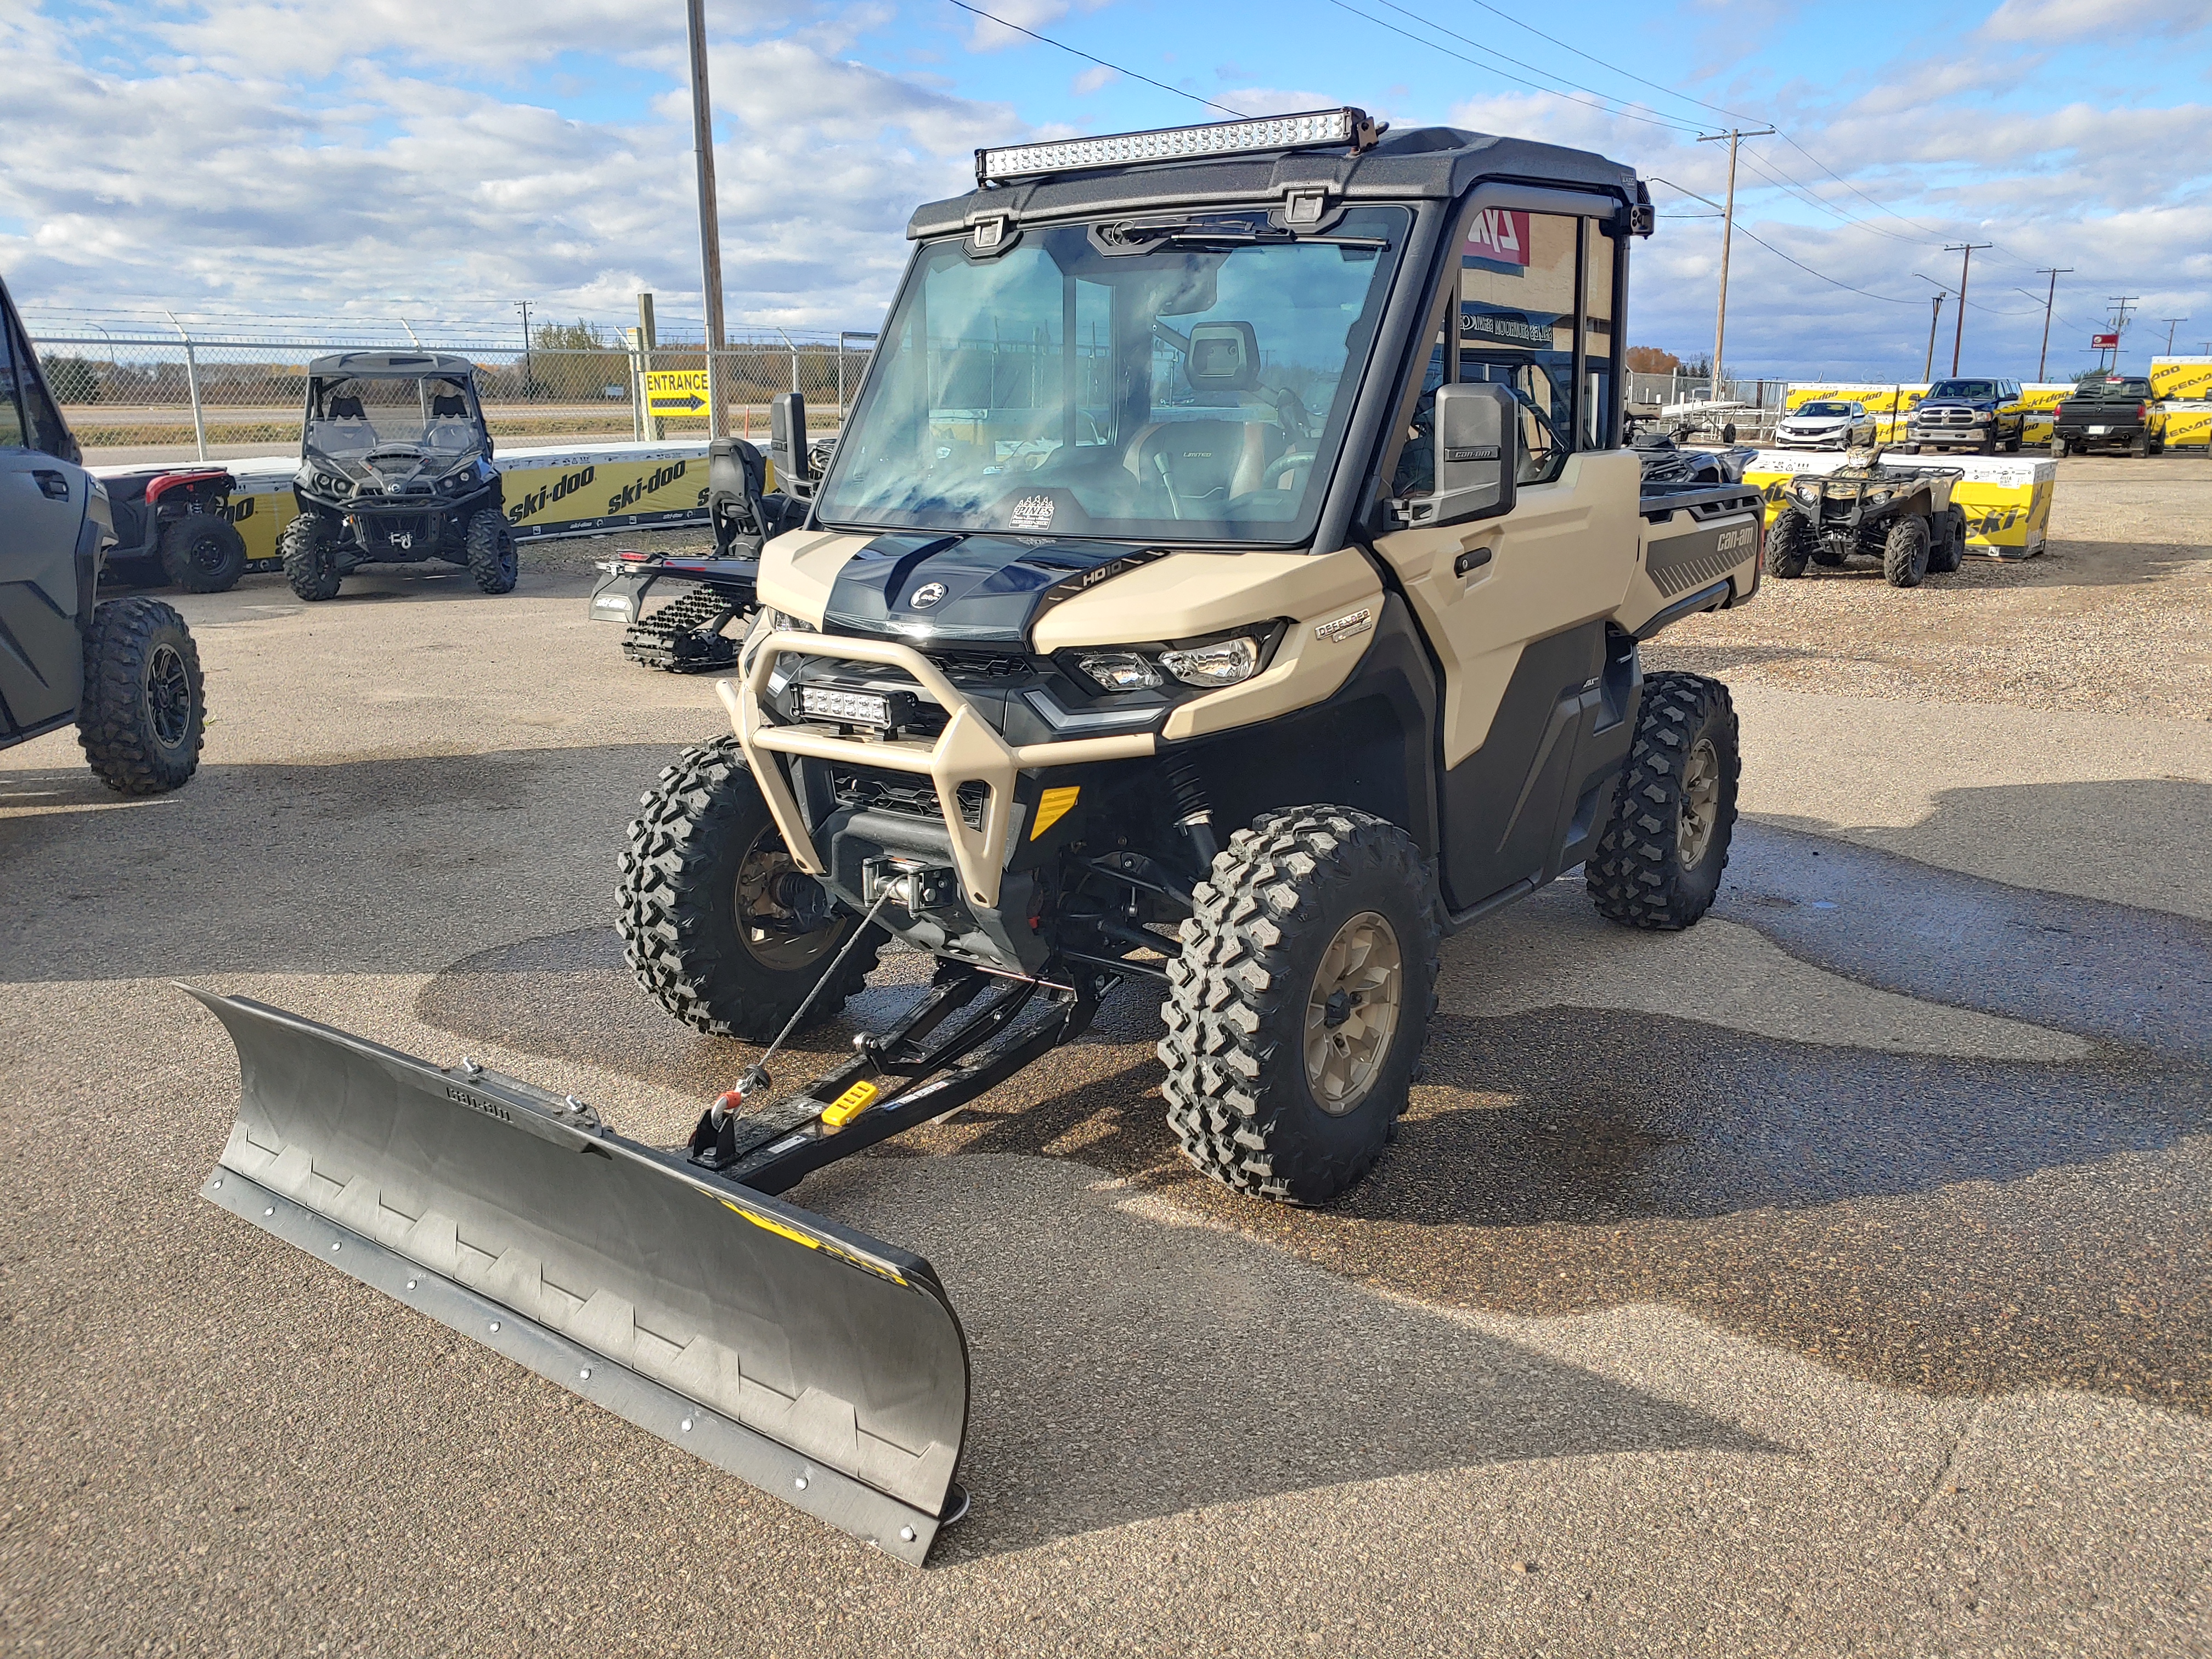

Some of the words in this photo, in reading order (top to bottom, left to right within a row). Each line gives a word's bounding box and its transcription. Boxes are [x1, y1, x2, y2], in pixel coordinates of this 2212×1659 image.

[647, 374, 708, 391] ENTRANCE
[508, 466, 594, 525] ski-doo
[608, 460, 686, 515] ski-doo
[1014, 506, 1054, 517] PINES
[1717, 526, 1753, 551] can-am
[1083, 561, 1122, 586] HD10
